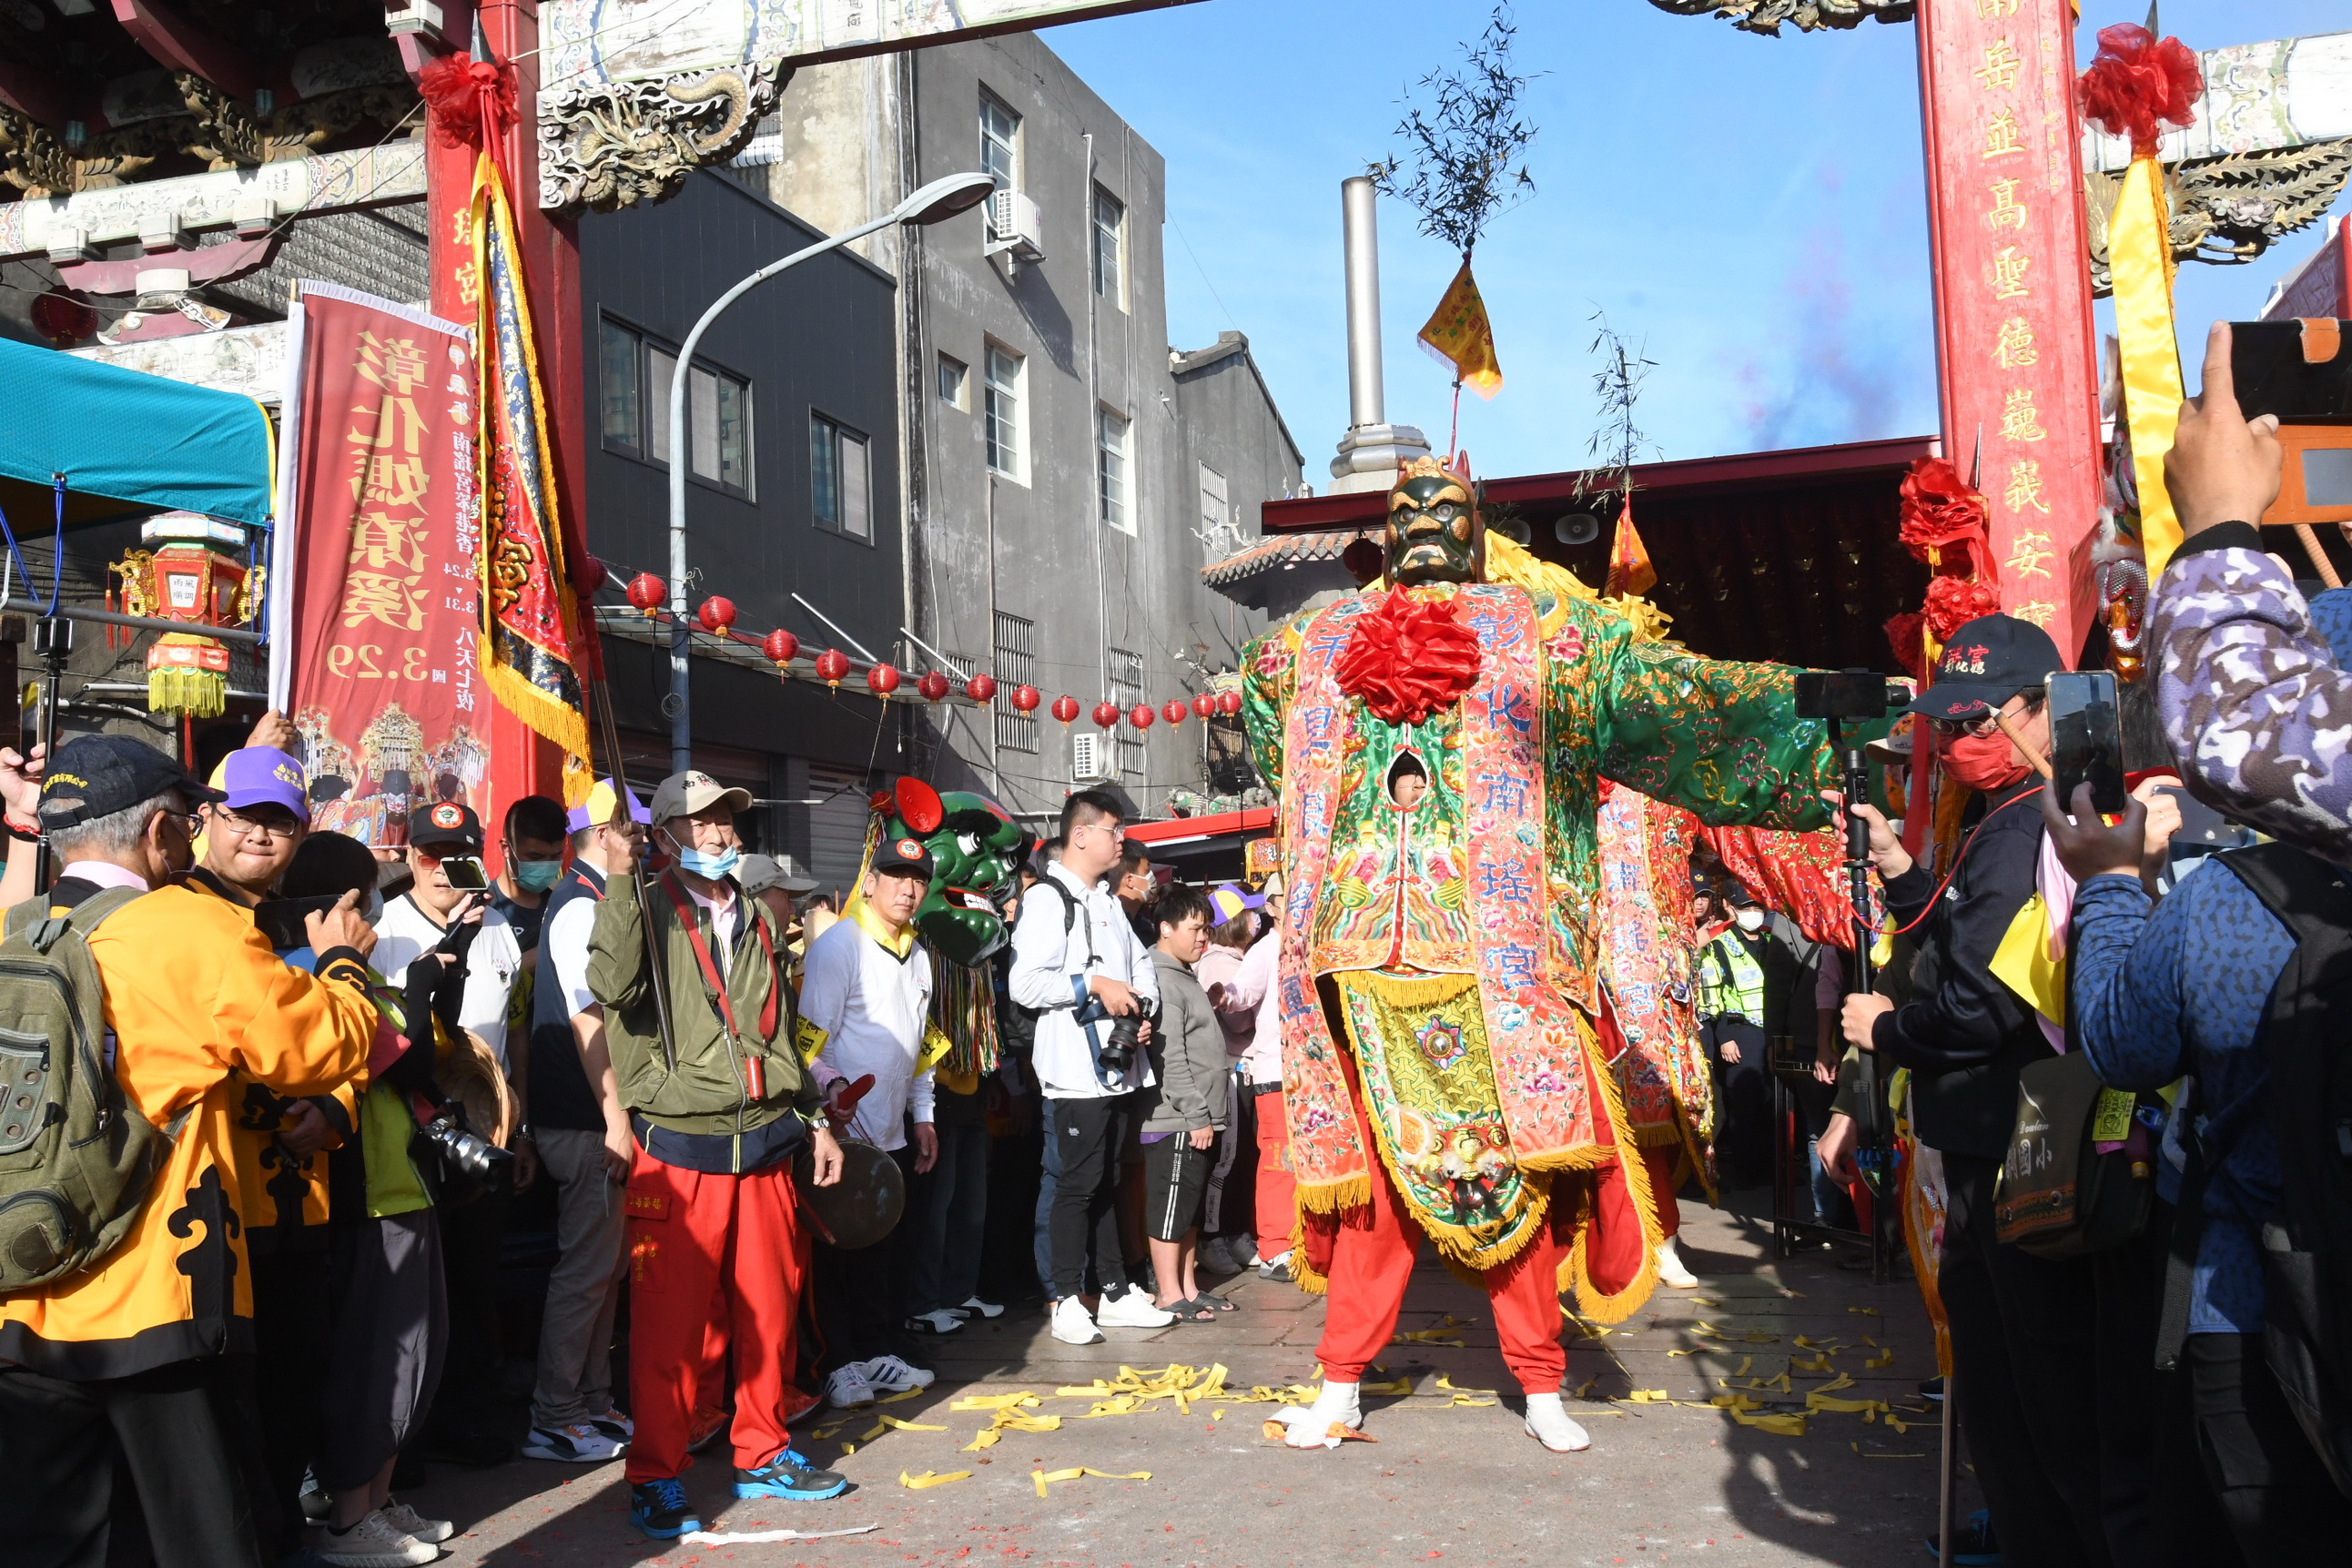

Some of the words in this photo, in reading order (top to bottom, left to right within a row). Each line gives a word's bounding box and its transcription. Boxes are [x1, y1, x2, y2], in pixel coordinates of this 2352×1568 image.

[1466, 612, 1536, 992] 彰化南瑤宮
[2018, 1118, 2050, 1135] Doulan
